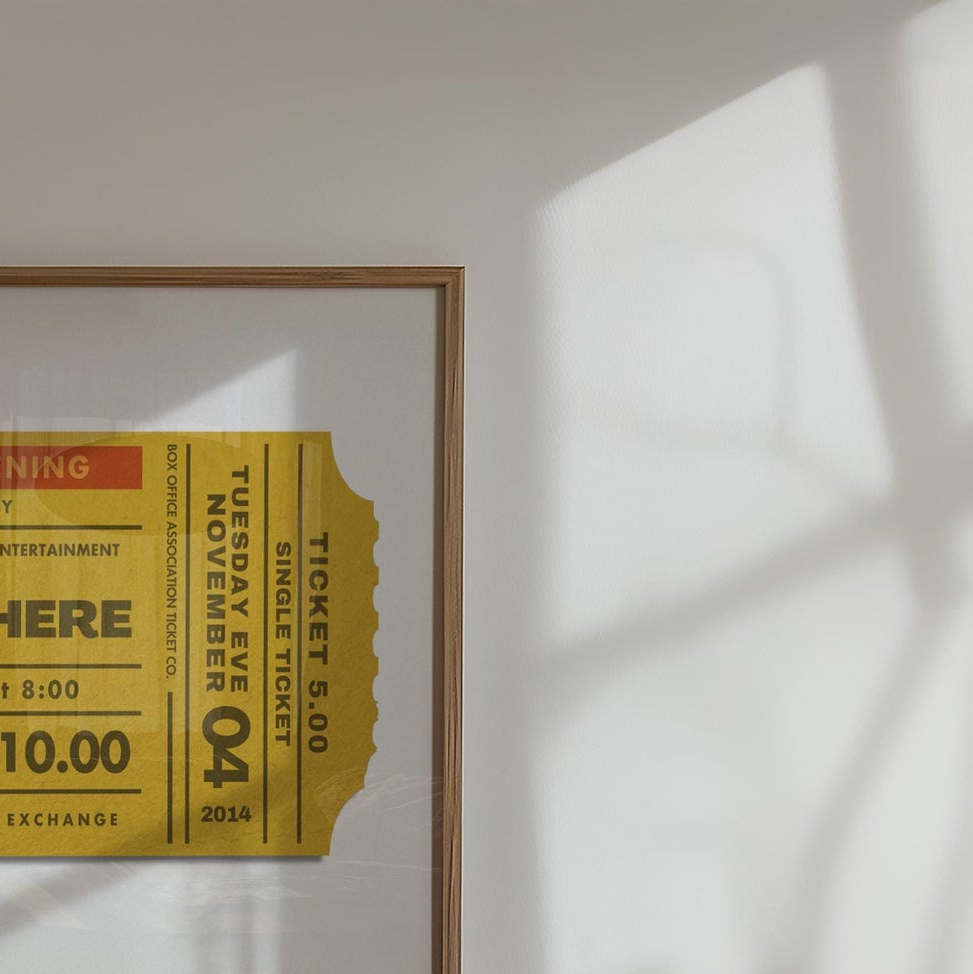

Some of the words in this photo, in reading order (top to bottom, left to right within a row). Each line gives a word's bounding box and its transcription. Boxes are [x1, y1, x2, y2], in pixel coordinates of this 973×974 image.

[166, 444, 177, 472] BOX
[166, 474, 177, 520] OFFICE
[166, 521, 177, 609] ASSOCIATION
[230, 465, 250, 619] TUESDAY
[206, 493, 227, 693] NOVEMBER
[275, 541, 292, 639] SINGLE
[309, 532, 329, 665] TICKET
[166, 611, 177, 653] TICKET
[230, 630, 250, 693] EVE
[21, 680, 80, 700] 8:00
[166, 656, 177, 680] CO.
[274, 648, 291, 747] TICKET
[201, 705, 252, 789] 04
[307, 680, 329, 754] 5.00
[0, 730, 131, 774] 10.00
[7, 813, 119, 827] EXCHANGE
[201, 805, 252, 823] 2014
